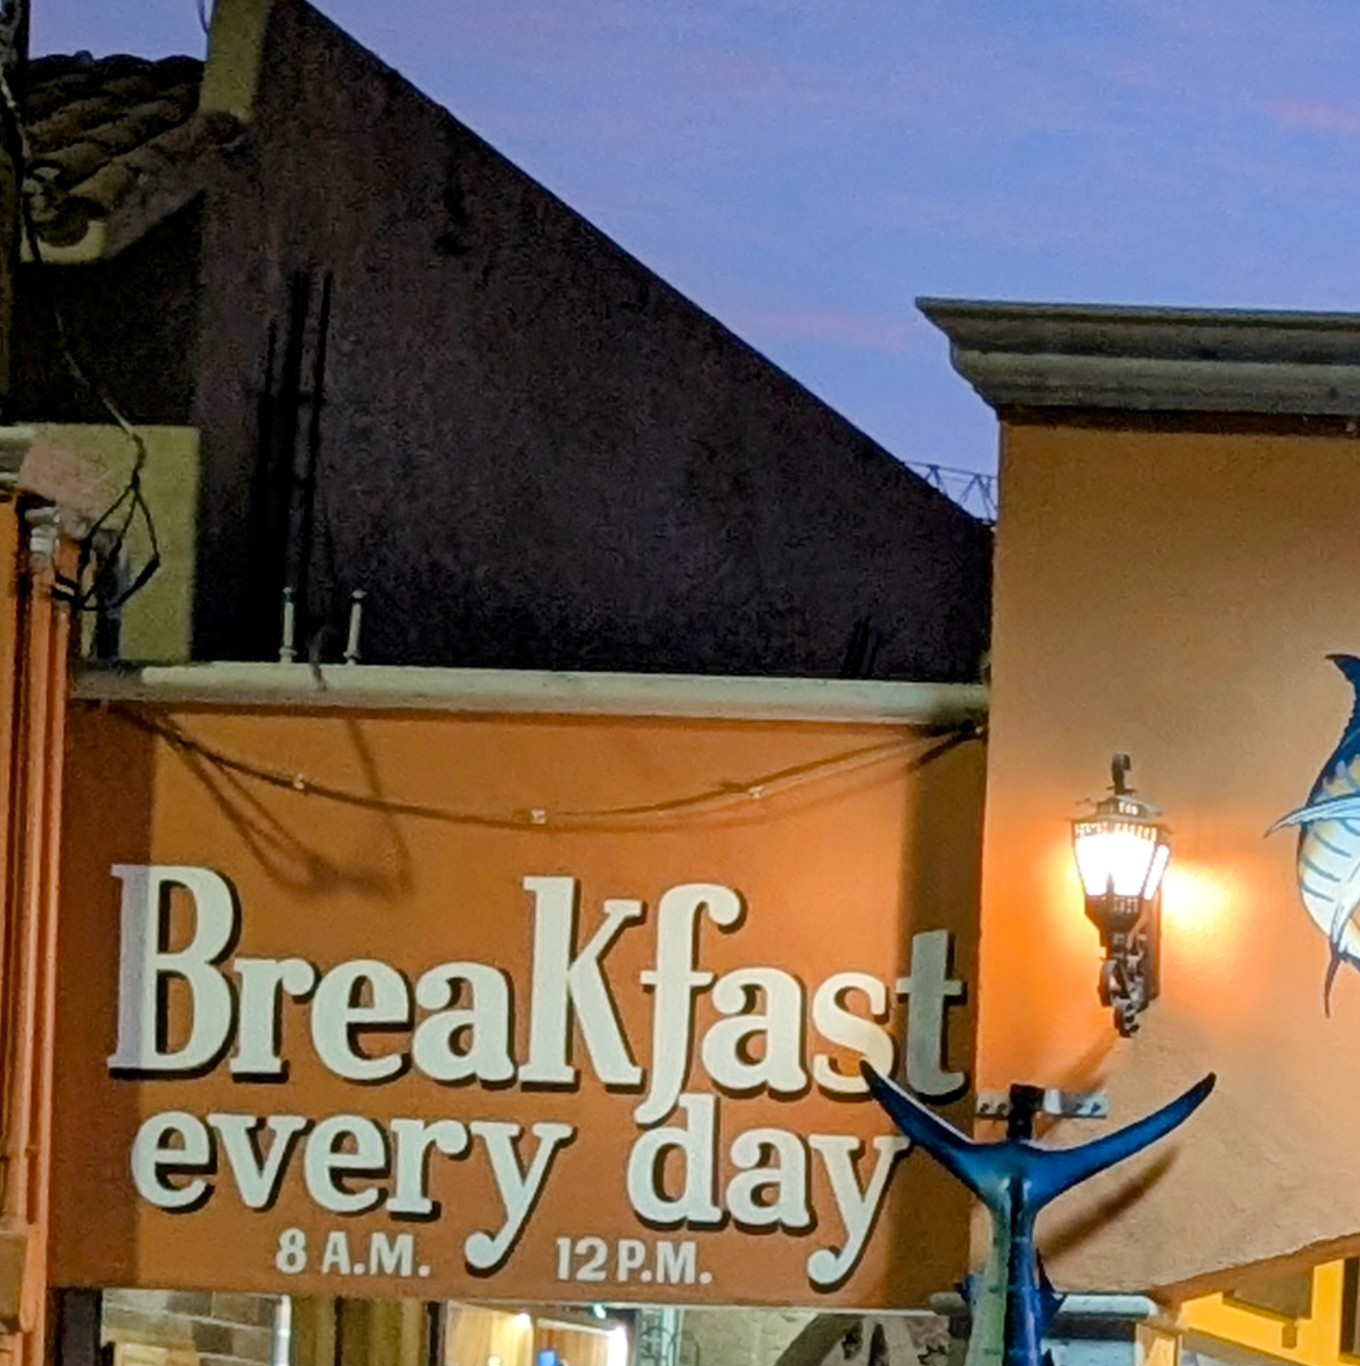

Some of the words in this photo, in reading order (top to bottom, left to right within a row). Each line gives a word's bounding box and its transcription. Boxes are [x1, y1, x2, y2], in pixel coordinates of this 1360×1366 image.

[107, 863, 970, 1126] Breakfast
[131, 1106, 575, 1274] every
[627, 1095, 912, 1288] day
[275, 1228, 308, 1275] 8
[322, 1230, 432, 1278] A.M.
